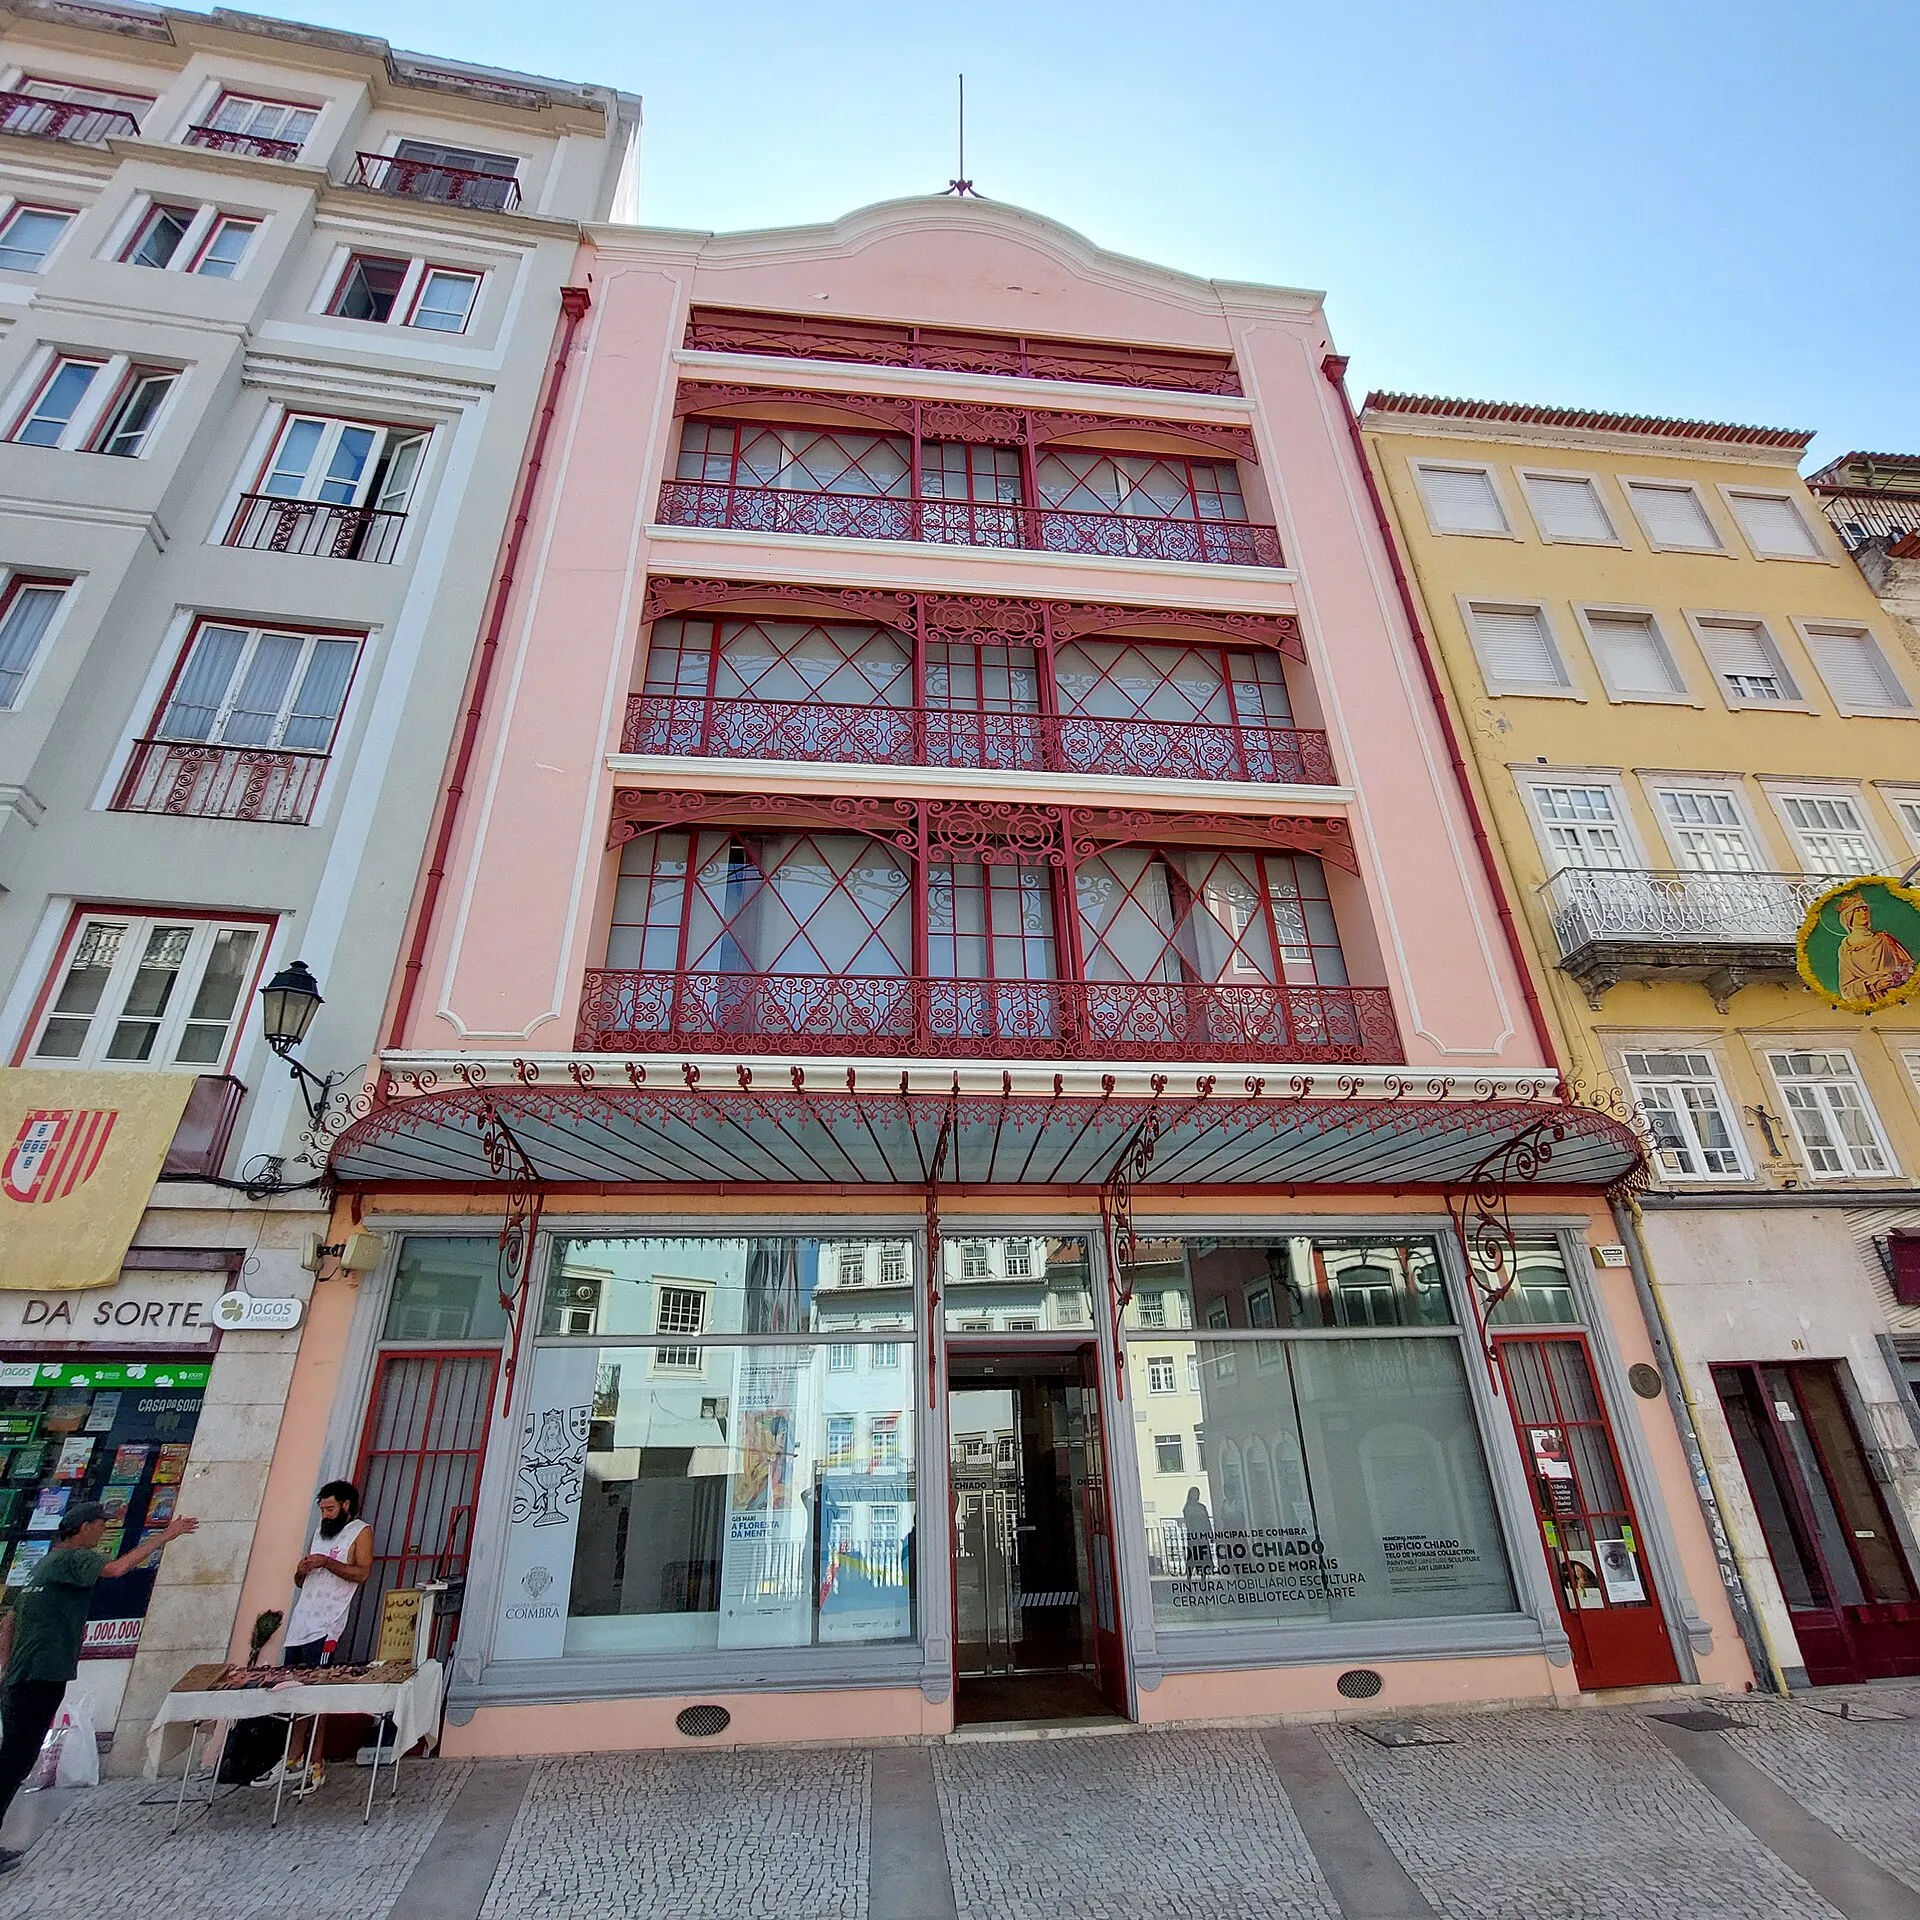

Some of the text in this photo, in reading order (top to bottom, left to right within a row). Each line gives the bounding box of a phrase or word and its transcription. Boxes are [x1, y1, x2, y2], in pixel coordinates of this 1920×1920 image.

[22, 1300, 203, 1328] DA SORTE
[246, 1302, 292, 1319] JOGOS
[0, 1367, 33, 1379] JOGOS
[954, 1481, 987, 1490] CHIADO
[731, 1520, 780, 1530] A FLORESTA
[731, 1530, 743, 1538] DA
[1200, 1530, 1250, 1541] MUNICIPAL
[1251, 1529, 1264, 1538] DE
[1265, 1527, 1308, 1537] COIMBRA
[1251, 1539, 1325, 1558] CHIADO
[1423, 1539, 1460, 1550] CHIADO
[1437, 1548, 1476, 1556] COLLECTION
[1233, 1562, 1265, 1575] TELO
[1269, 1561, 1286, 1573] DE
[1288, 1558, 1339, 1572] MORAIS
[1171, 1581, 1225, 1594] PINTURA
[1299, 1572, 1367, 1587] ESCULTURA
[1237, 1589, 1306, 1604] BIBLIOTECA
[1307, 1589, 1323, 1600] DE
[1326, 1586, 1356, 1599] ARTE
[505, 1607, 560, 1620] COIMBRA
